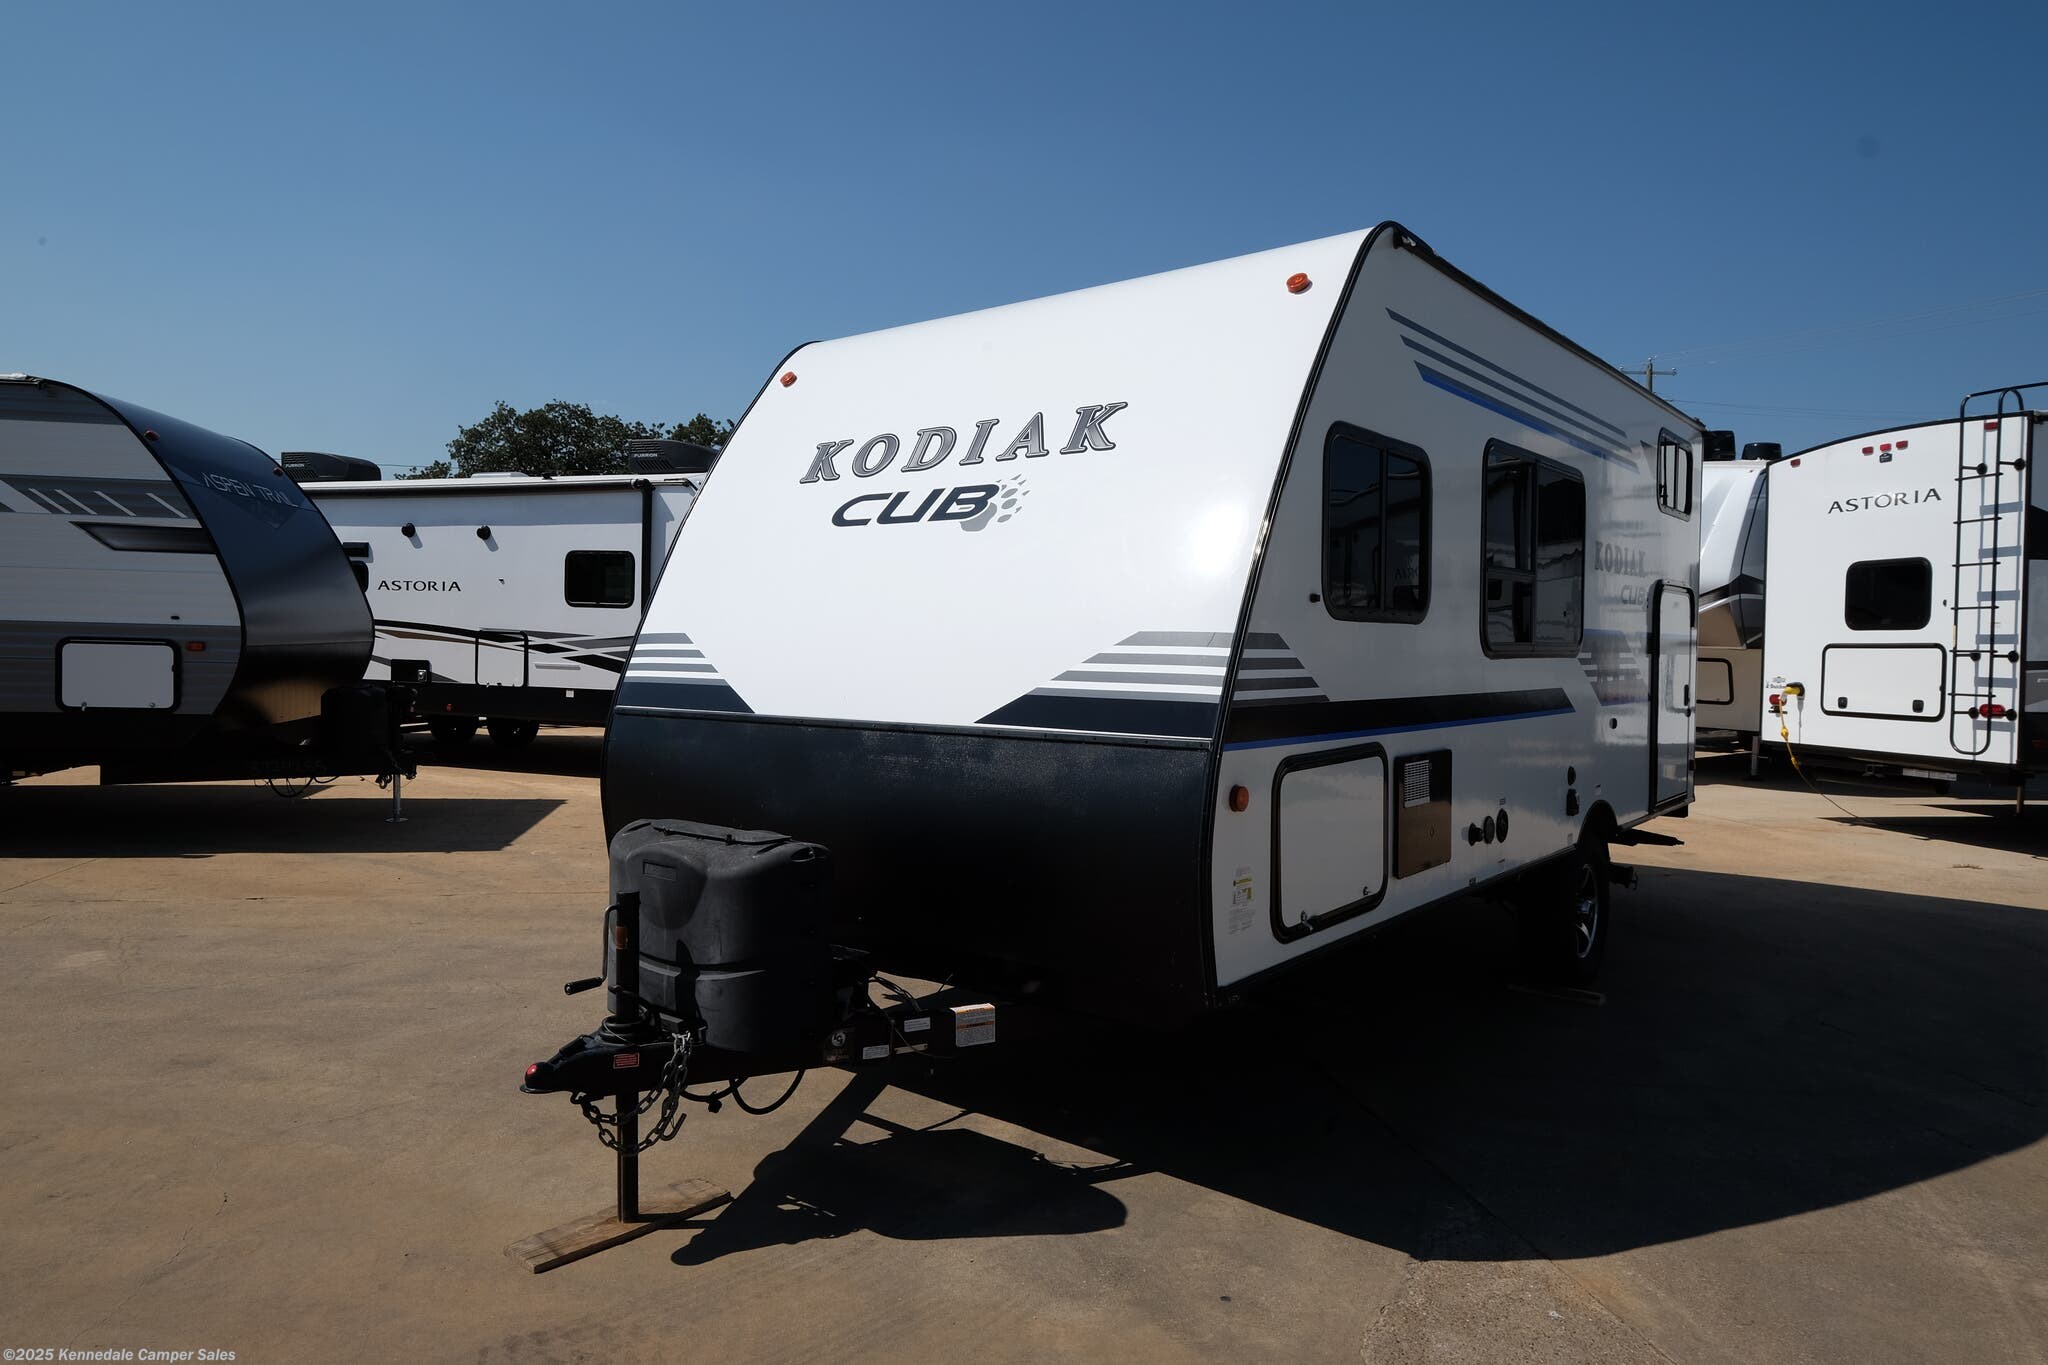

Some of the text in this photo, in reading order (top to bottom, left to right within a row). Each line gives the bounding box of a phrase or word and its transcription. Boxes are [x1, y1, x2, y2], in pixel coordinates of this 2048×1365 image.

[800, 402, 1128, 484] KODIAK
[200, 471, 299, 508] ASPEN TRAIL
[831, 483, 1000, 528] CUB
[1827, 487, 1942, 514] ASTORIA
[1594, 540, 1646, 577] KODIAK
[377, 579, 461, 593] ASTORIA
[1621, 584, 1645, 606] CUB
